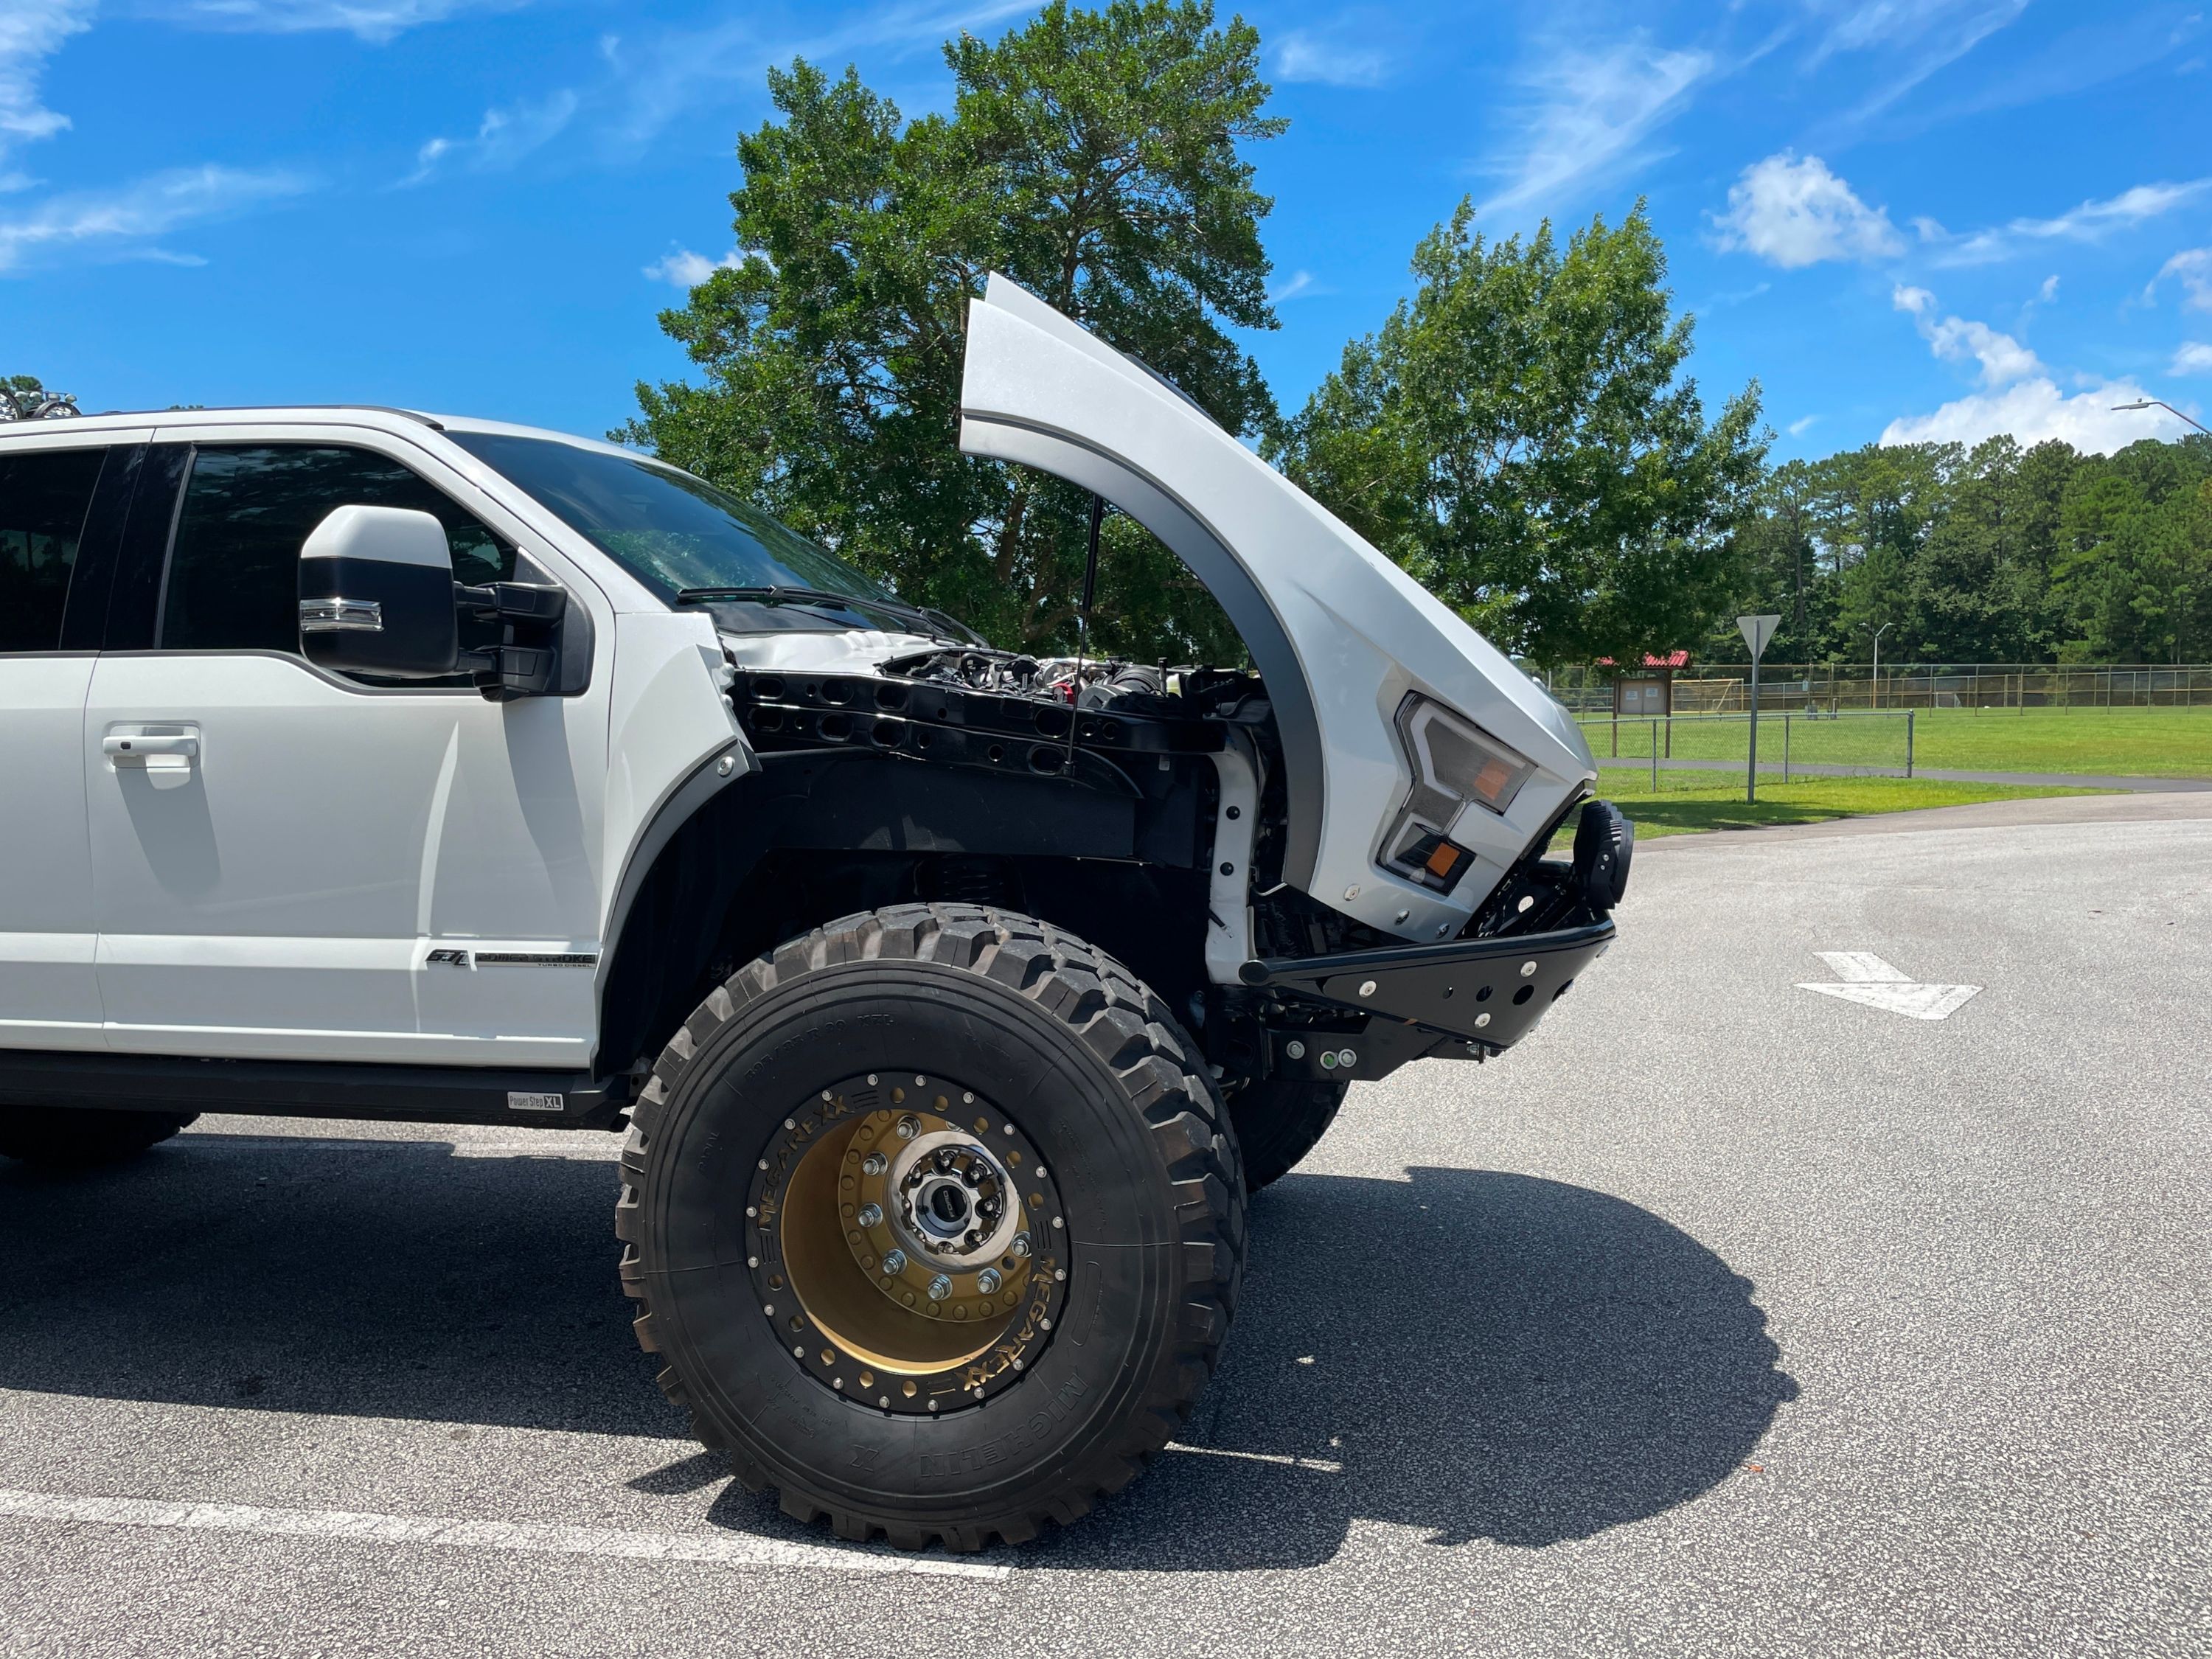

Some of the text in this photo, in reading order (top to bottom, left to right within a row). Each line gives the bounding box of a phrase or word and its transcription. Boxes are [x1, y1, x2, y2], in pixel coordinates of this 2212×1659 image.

[509, 1096, 560, 1109] Power Step XL
[849, 1372, 1089, 1478] MICHELIN X
